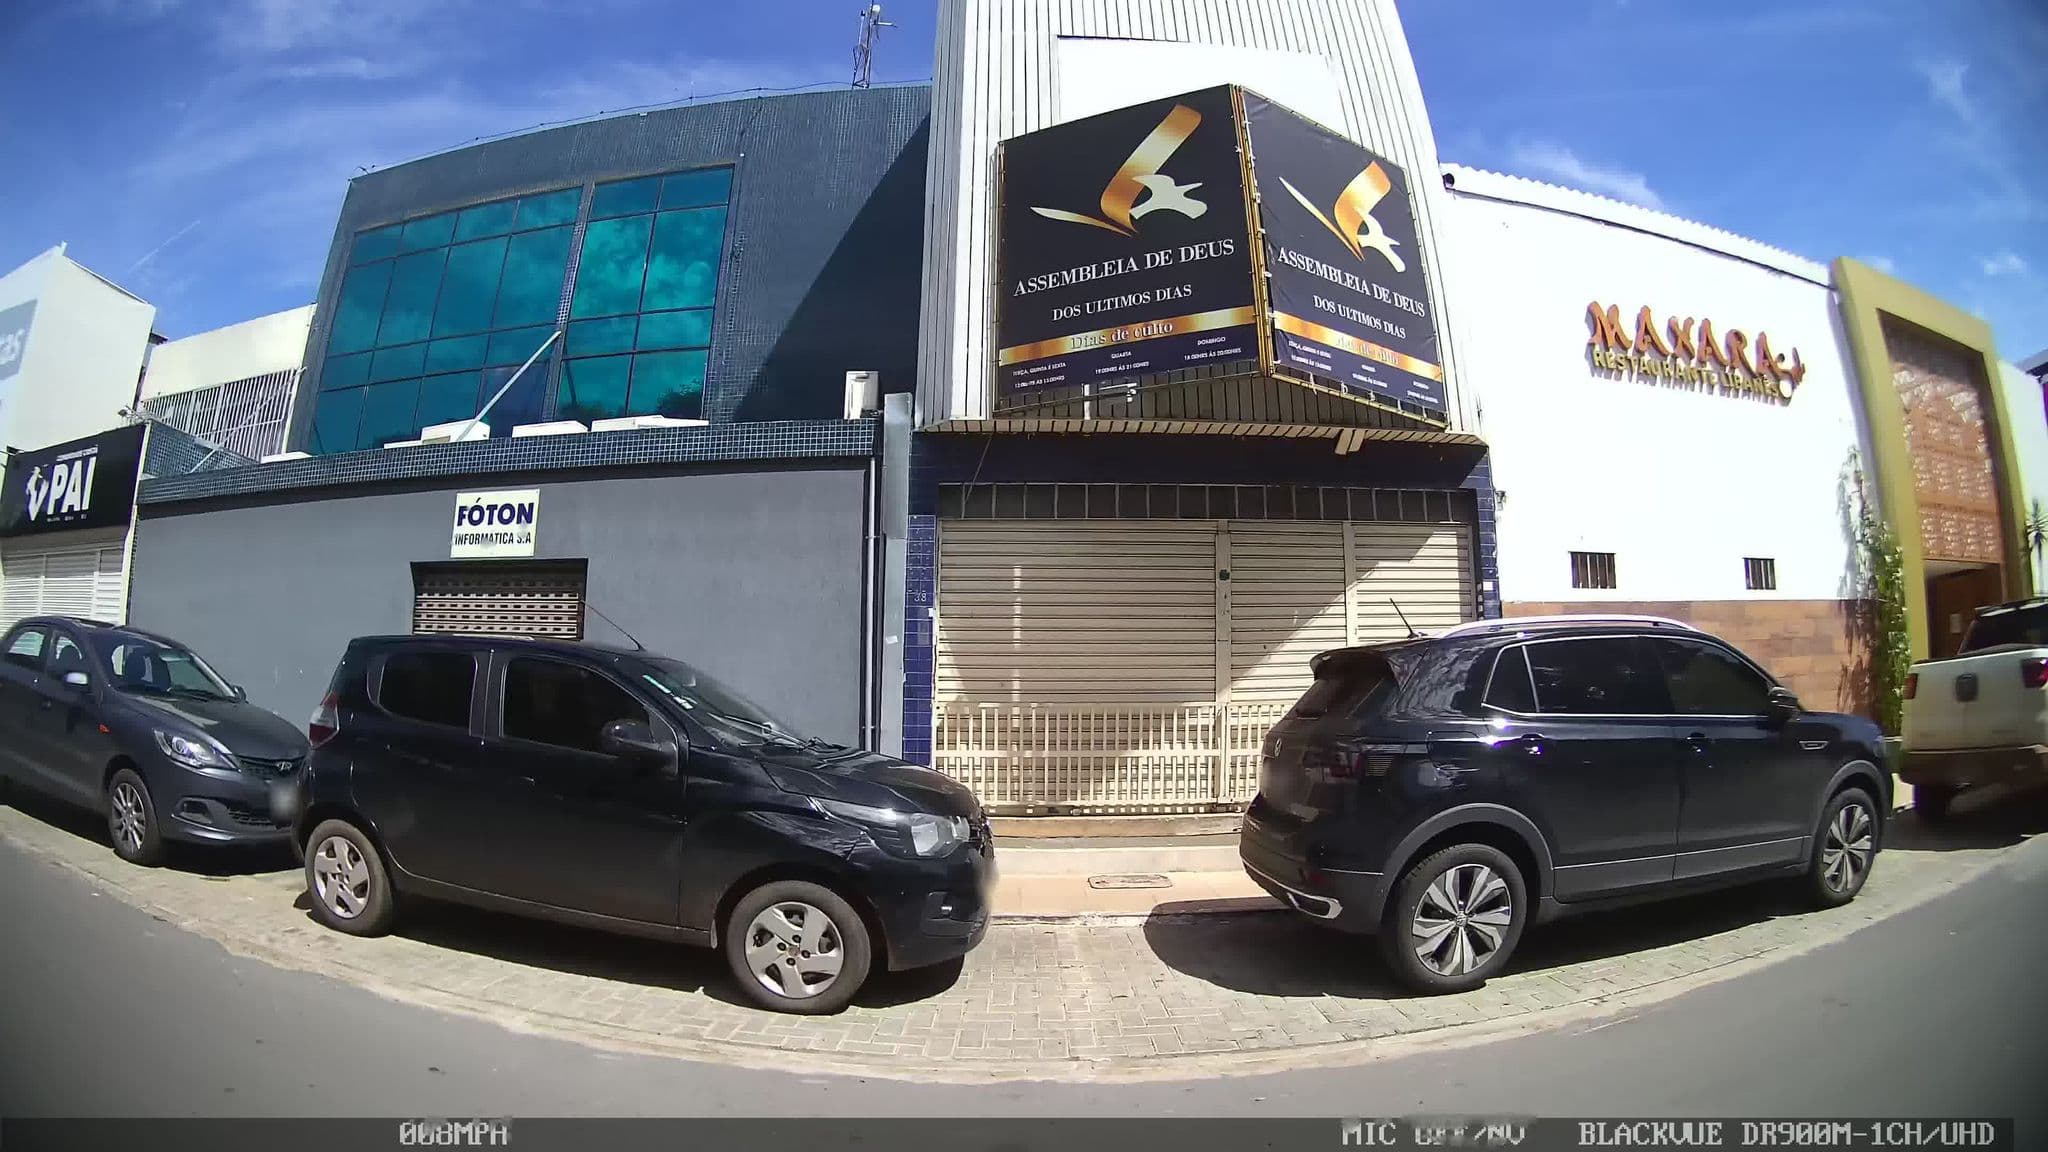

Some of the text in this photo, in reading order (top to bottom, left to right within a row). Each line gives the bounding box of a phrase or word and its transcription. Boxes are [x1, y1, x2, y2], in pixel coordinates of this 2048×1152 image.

[1013, 238, 1235, 297] ASSEMBLEIA DE DEUS
[1277, 247, 1425, 318] ASSEMBLEIA DE DEUS
[1053, 284, 1193, 321] DOS ULTIMOS DIAS
[1313, 294, 1406, 339] DOS ULTIMOS DIAS
[1071, 322, 1173, 349] Dias de culto
[457, 497, 534, 527] FÓTON
